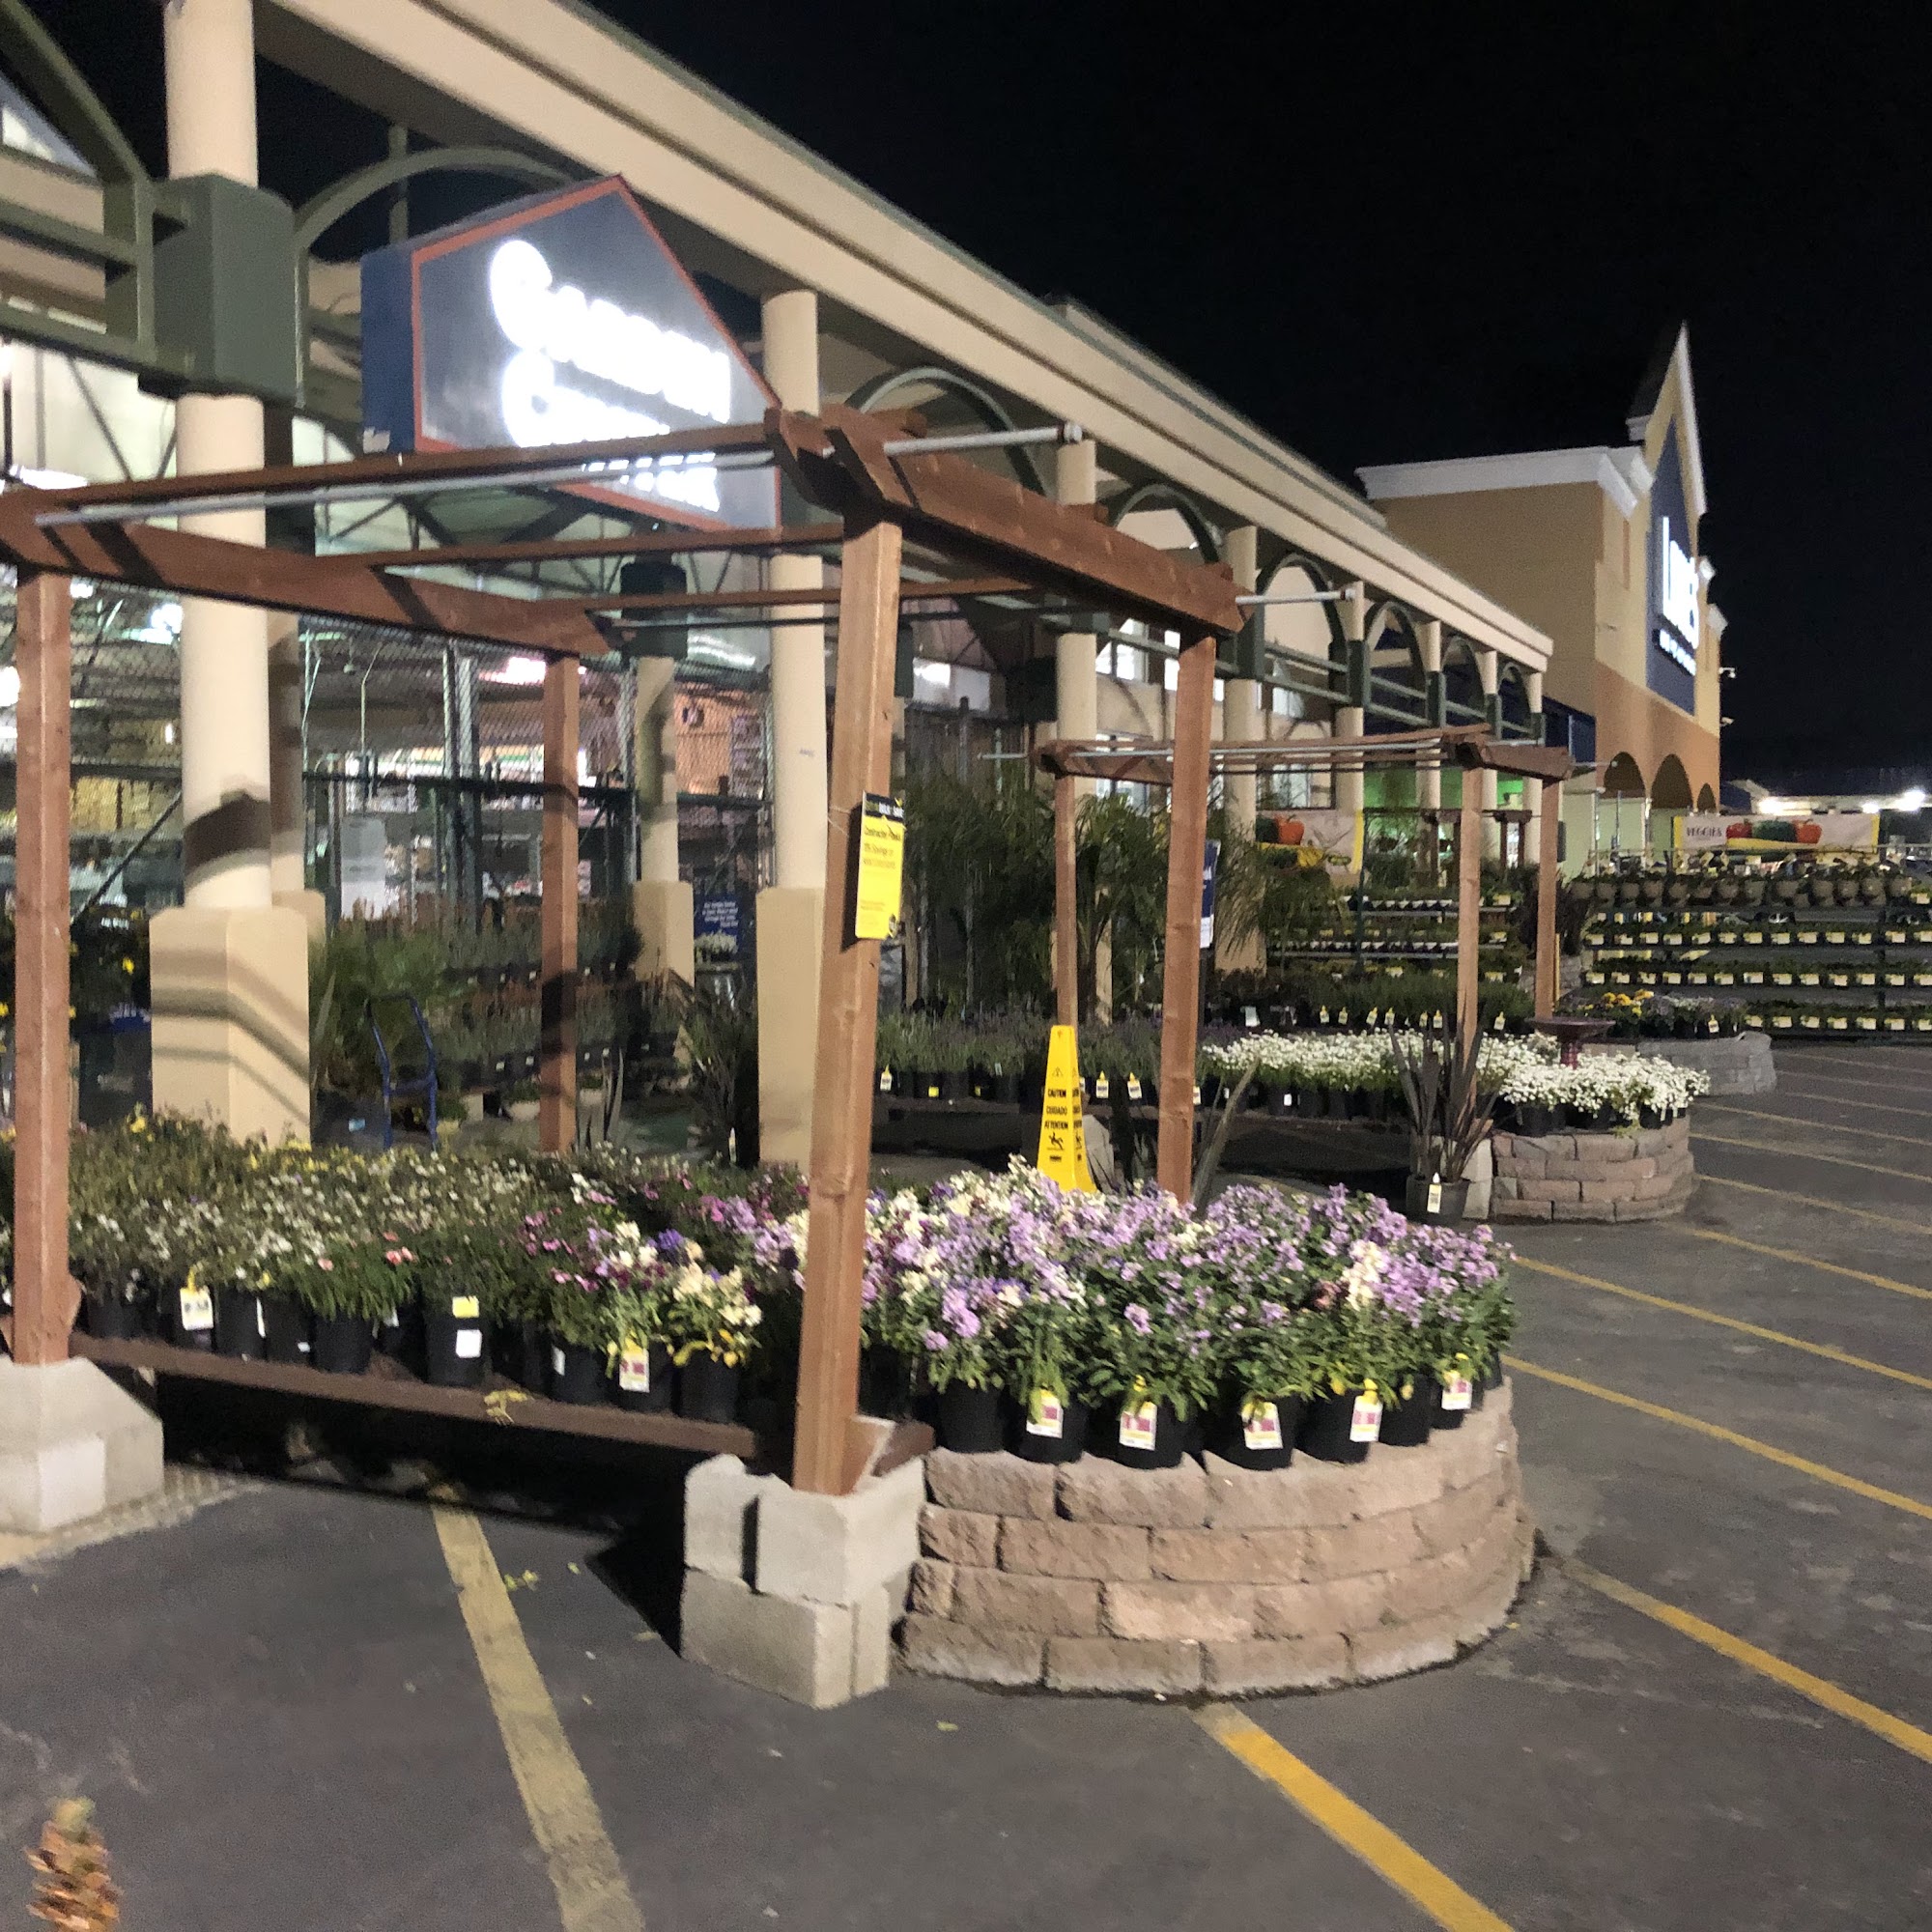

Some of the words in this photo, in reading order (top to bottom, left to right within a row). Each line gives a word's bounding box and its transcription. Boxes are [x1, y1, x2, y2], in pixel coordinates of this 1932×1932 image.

[1687, 827, 1721, 837] VEGGIES
[1047, 1089, 1066, 1097] CAUTION
[1046, 1106, 1067, 1116] CUIDADO
[1044, 1121, 1068, 1129] ATTENTION
